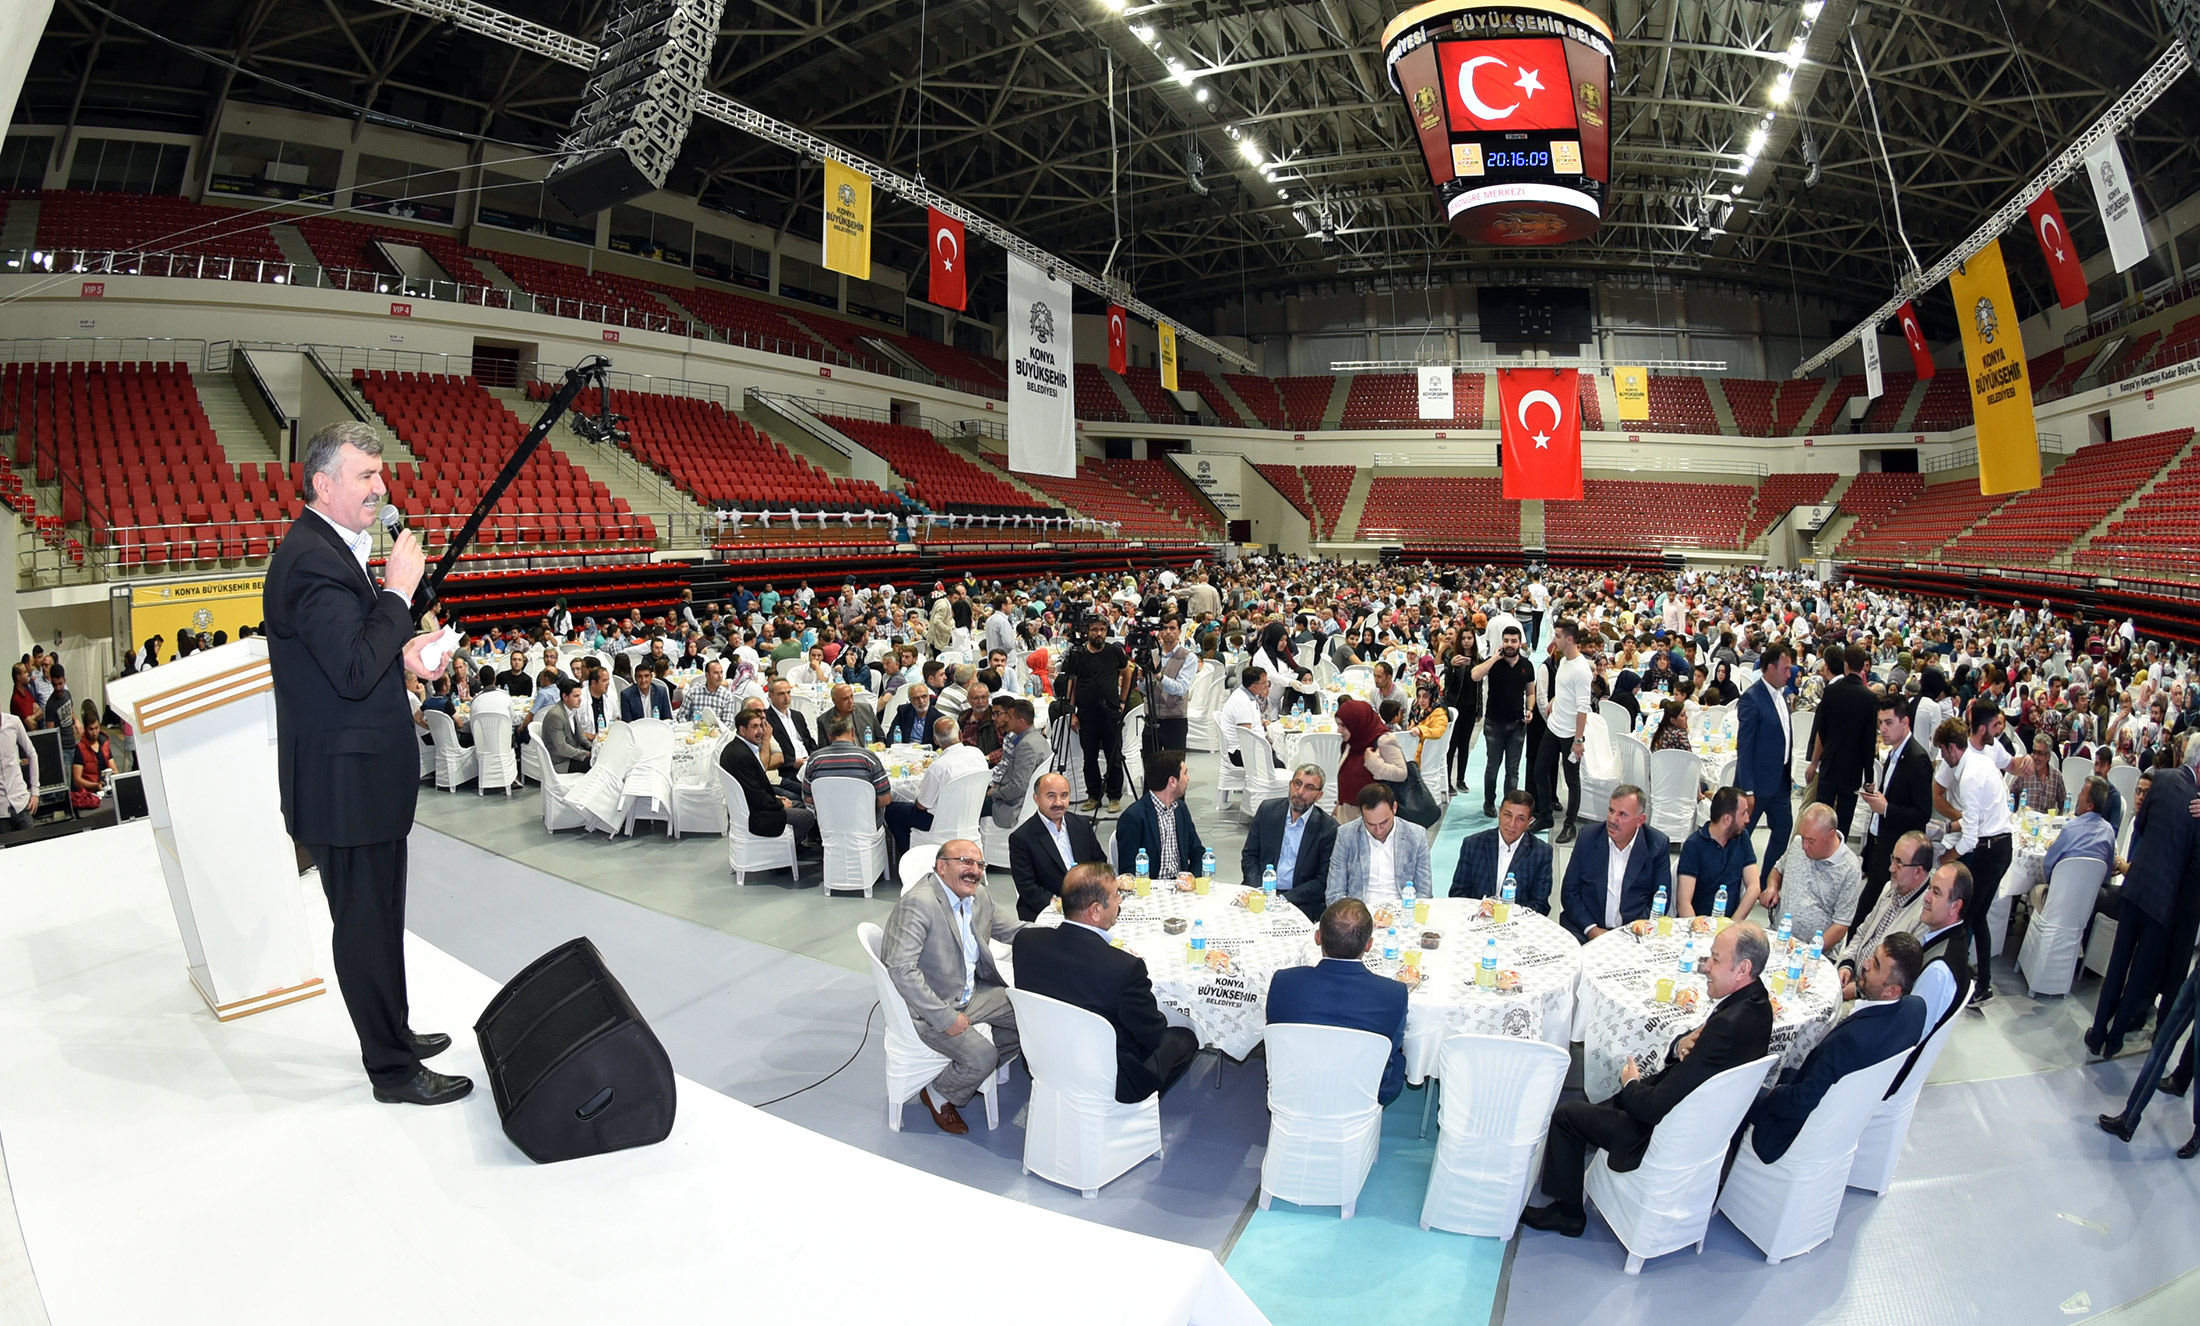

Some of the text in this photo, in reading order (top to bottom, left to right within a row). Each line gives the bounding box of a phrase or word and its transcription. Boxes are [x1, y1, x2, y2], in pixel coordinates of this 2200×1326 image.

[1452, 12, 1567, 36] BÜYÜKŞEHİR
[1487, 151, 1549, 167] 20:16:09
[1455, 194, 1482, 209] KONGRE
[1484, 187, 1526, 200] MERKEZİ
[836, 206, 856, 220] KONYA
[84, 285, 102, 295] VIP 5
[393, 306, 410, 315] VIP 4
[613, 333, 618, 341] 2
[1030, 346, 1055, 366] KONYA
[1982, 347, 2006, 369] KONYA
[1016, 357, 1067, 388] BÜYÜKŞEHİR
[1975, 360, 2022, 395] BÜYÜKŞEHİR
[2161, 369, 2177, 380] Kadar
[1027, 381, 1058, 398] BELEDİYESİ
[1986, 384, 2016, 405] BELEDİYESİ
[175, 585, 200, 596] KONYA
[202, 581, 250, 594] BÜYÜKŞEHİR
[1215, 978, 1244, 989] KONYA
[1197, 985, 1258, 1003] BÜYÜKŞEHİR
[1205, 998, 1242, 1008] BELEDİYESİ
